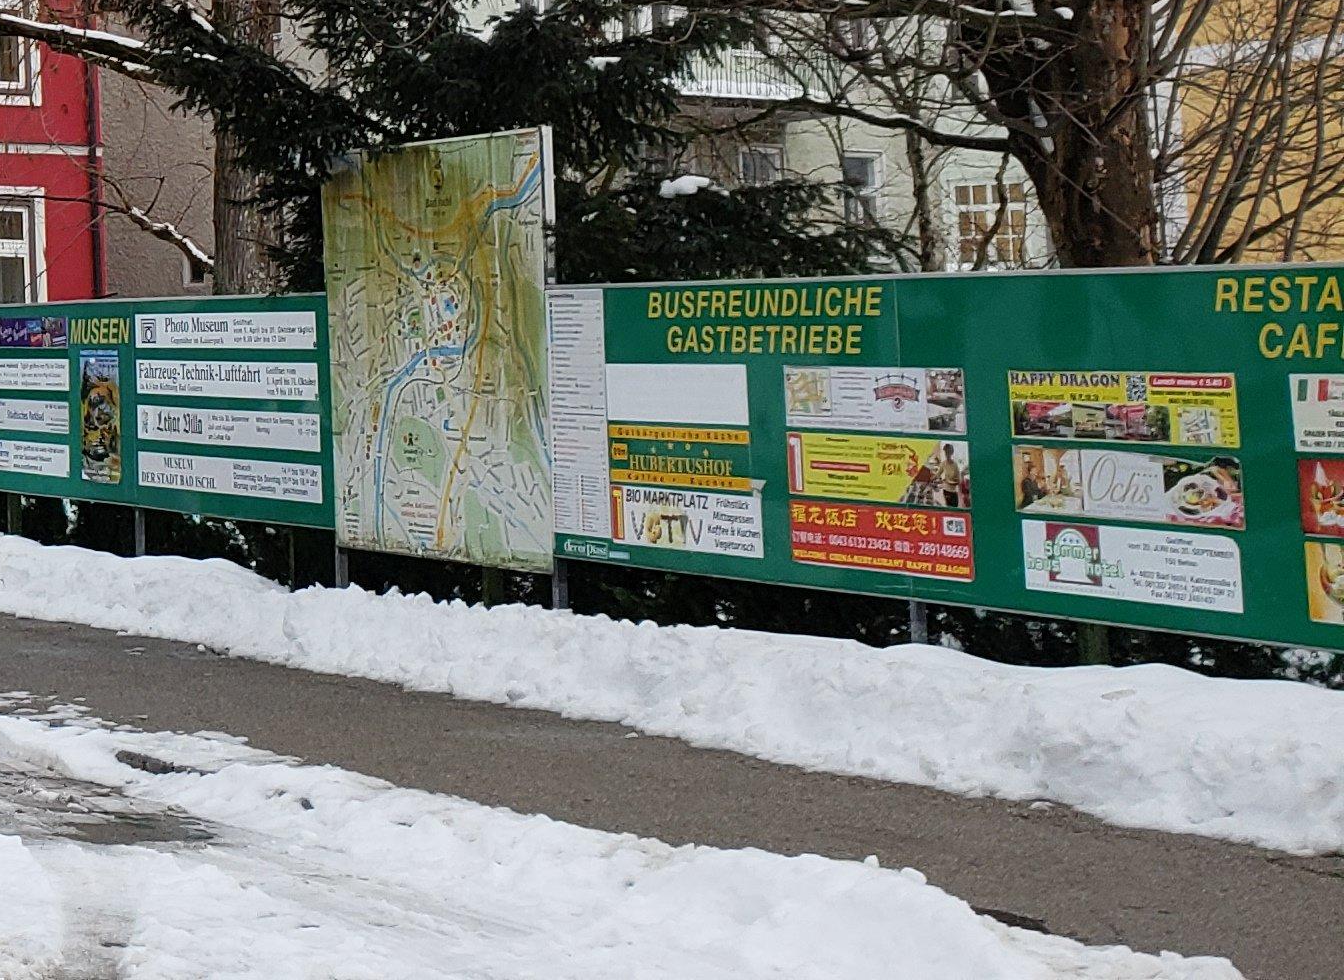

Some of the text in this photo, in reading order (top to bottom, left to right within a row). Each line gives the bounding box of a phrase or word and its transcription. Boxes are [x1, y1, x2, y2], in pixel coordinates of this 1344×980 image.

[647, 287, 883, 318] BUSFREUNDLICHE
[70, 318, 130, 345] MUSEEN
[164, 317, 229, 333] Photo Museum
[667, 325, 863, 354] GASTBETRIEBE
[1259, 322, 1344, 359] CAF
[1011, 372, 1120, 387] HAPPY DRAGON
[163, 457, 194, 470] MUSEUM
[629, 454, 733, 476] HUBERTUSHOF
[141, 471, 156, 482] DER
[156, 472, 178, 486] STADT
[179, 475, 194, 487] BAD
[1087, 453, 1153, 505] Ochs
[626, 489, 708, 510] BIO MARKTPLATZ
[716, 498, 750, 510] Frühstück
[1044, 539, 1099, 562] Sommer
